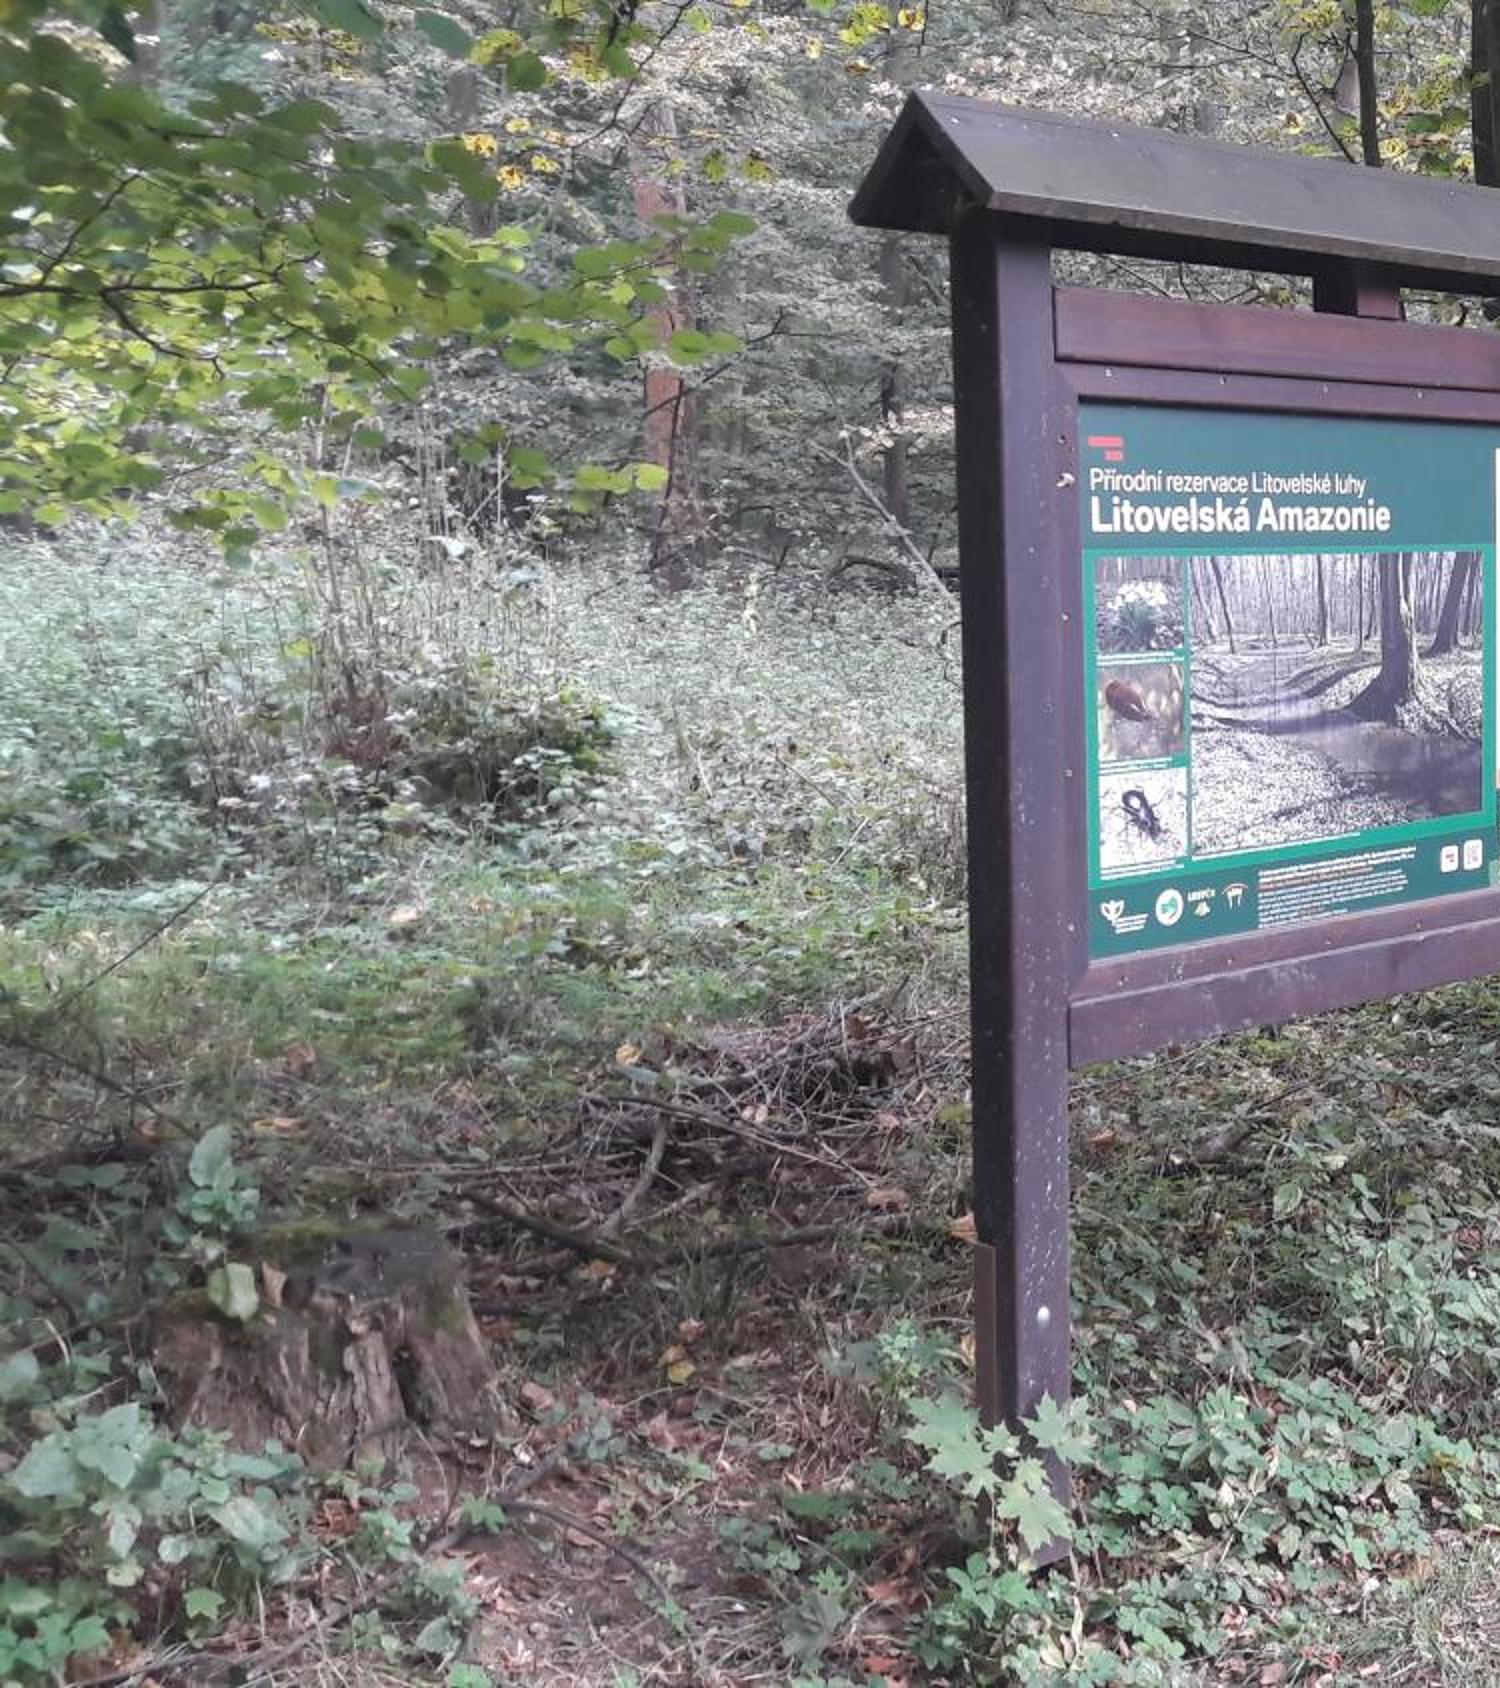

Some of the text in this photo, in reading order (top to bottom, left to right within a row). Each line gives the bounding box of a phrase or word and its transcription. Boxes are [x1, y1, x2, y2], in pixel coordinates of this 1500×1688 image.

[1090, 467, 1366, 498] Přírodní rezervace Litovelské luhy
[1091, 496, 1392, 533] Litovelská Amazonie
